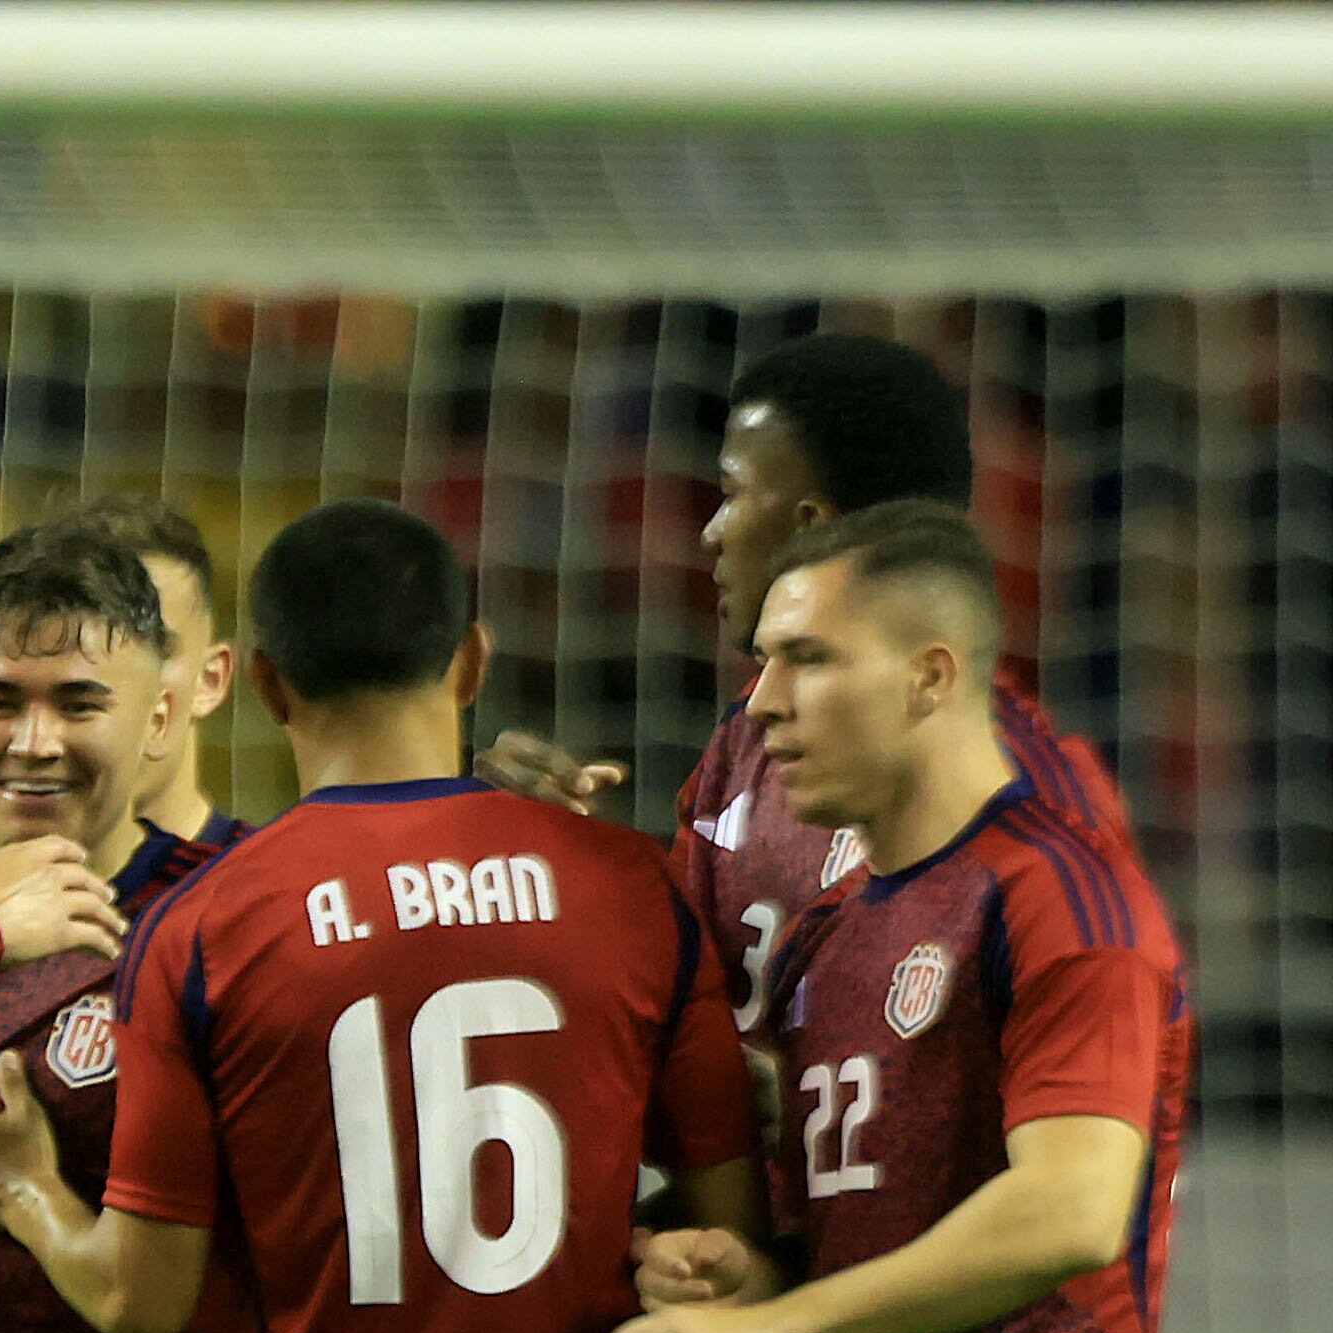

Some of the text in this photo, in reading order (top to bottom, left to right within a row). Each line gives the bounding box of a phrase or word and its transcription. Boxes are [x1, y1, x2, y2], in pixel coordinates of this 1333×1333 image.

[306, 854, 557, 946] A. BRAN
[328, 978, 566, 1305] 16
[799, 1055, 879, 1199] 22
